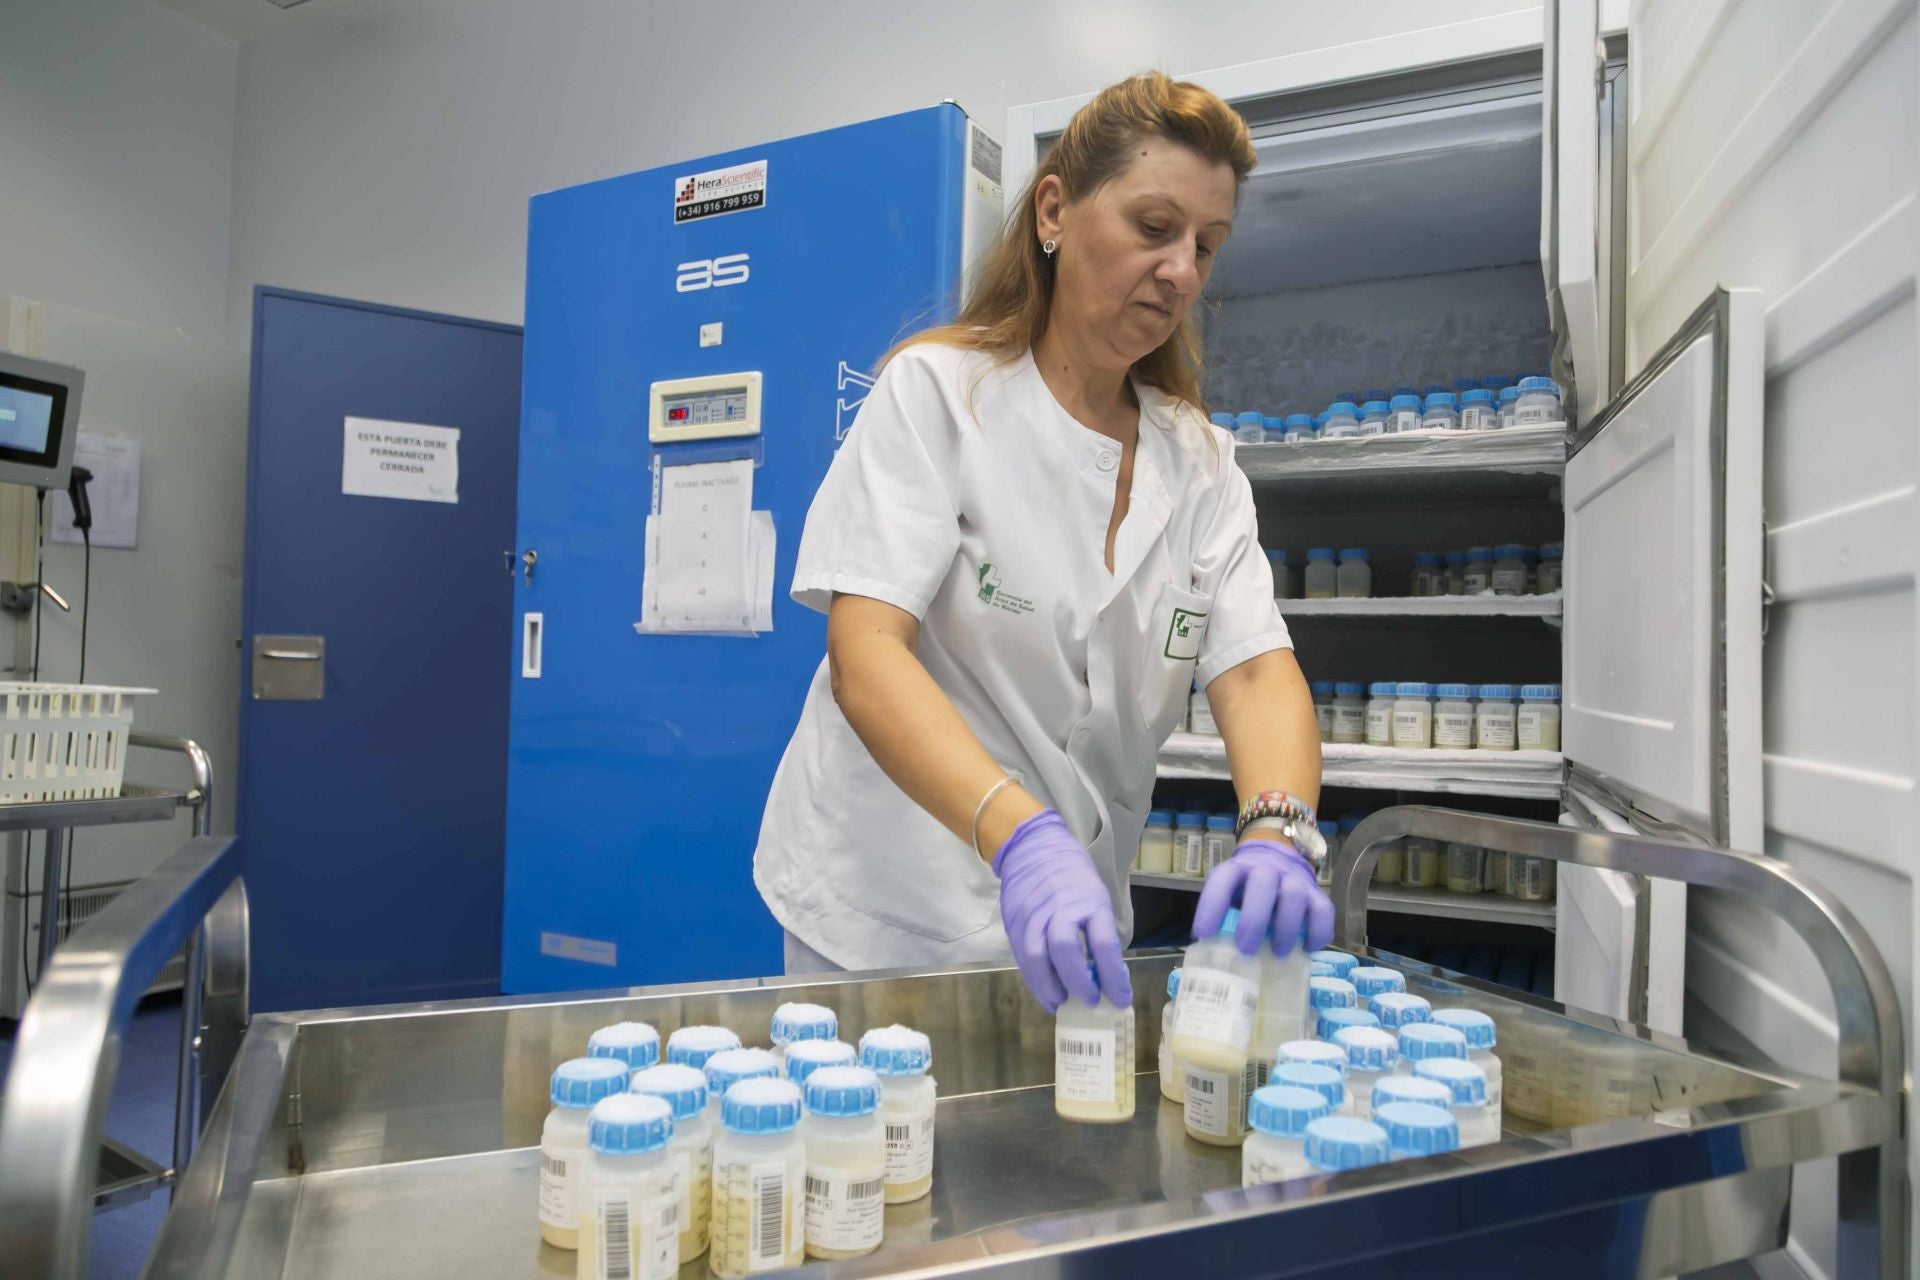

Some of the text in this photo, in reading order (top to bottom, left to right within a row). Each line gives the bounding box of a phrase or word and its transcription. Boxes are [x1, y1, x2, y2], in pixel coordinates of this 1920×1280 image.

[697, 168, 764, 190] HeraScientific
[678, 193, 759, 218] (+34) 916 799 959
[358, 433, 448, 450] ESTA PUERTA DEBE
[370, 448, 435, 462] PERMANECER
[379, 463, 424, 473] CERRADA
